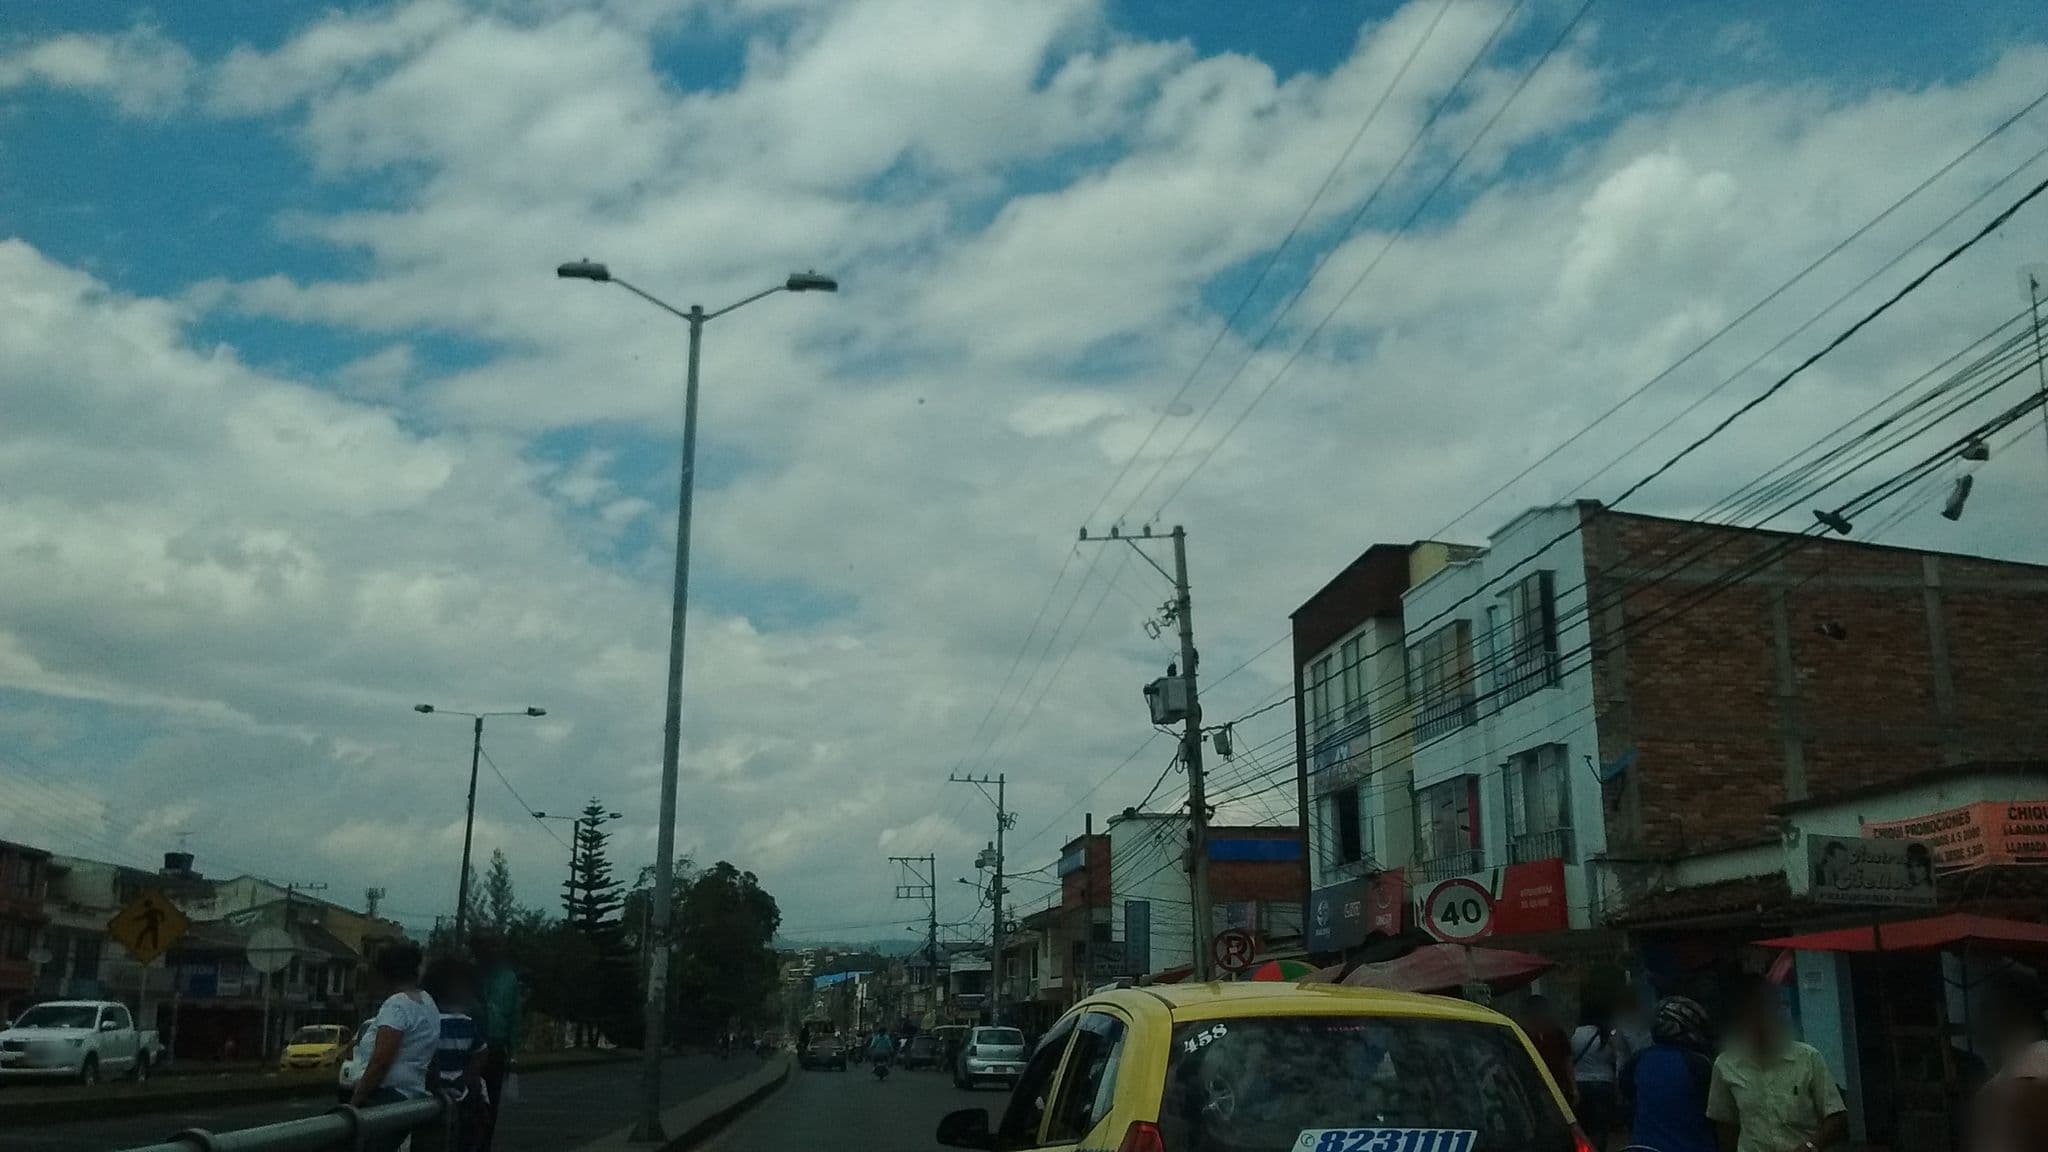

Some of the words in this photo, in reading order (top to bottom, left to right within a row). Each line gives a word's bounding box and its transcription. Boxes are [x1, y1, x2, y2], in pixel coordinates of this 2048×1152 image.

[1905, 811, 1970, 834] PROMOCIONES
[1441, 898, 1482, 926] 40
[1184, 1023, 1228, 1053] 458
[1316, 1130, 1473, 1152] 8231111
